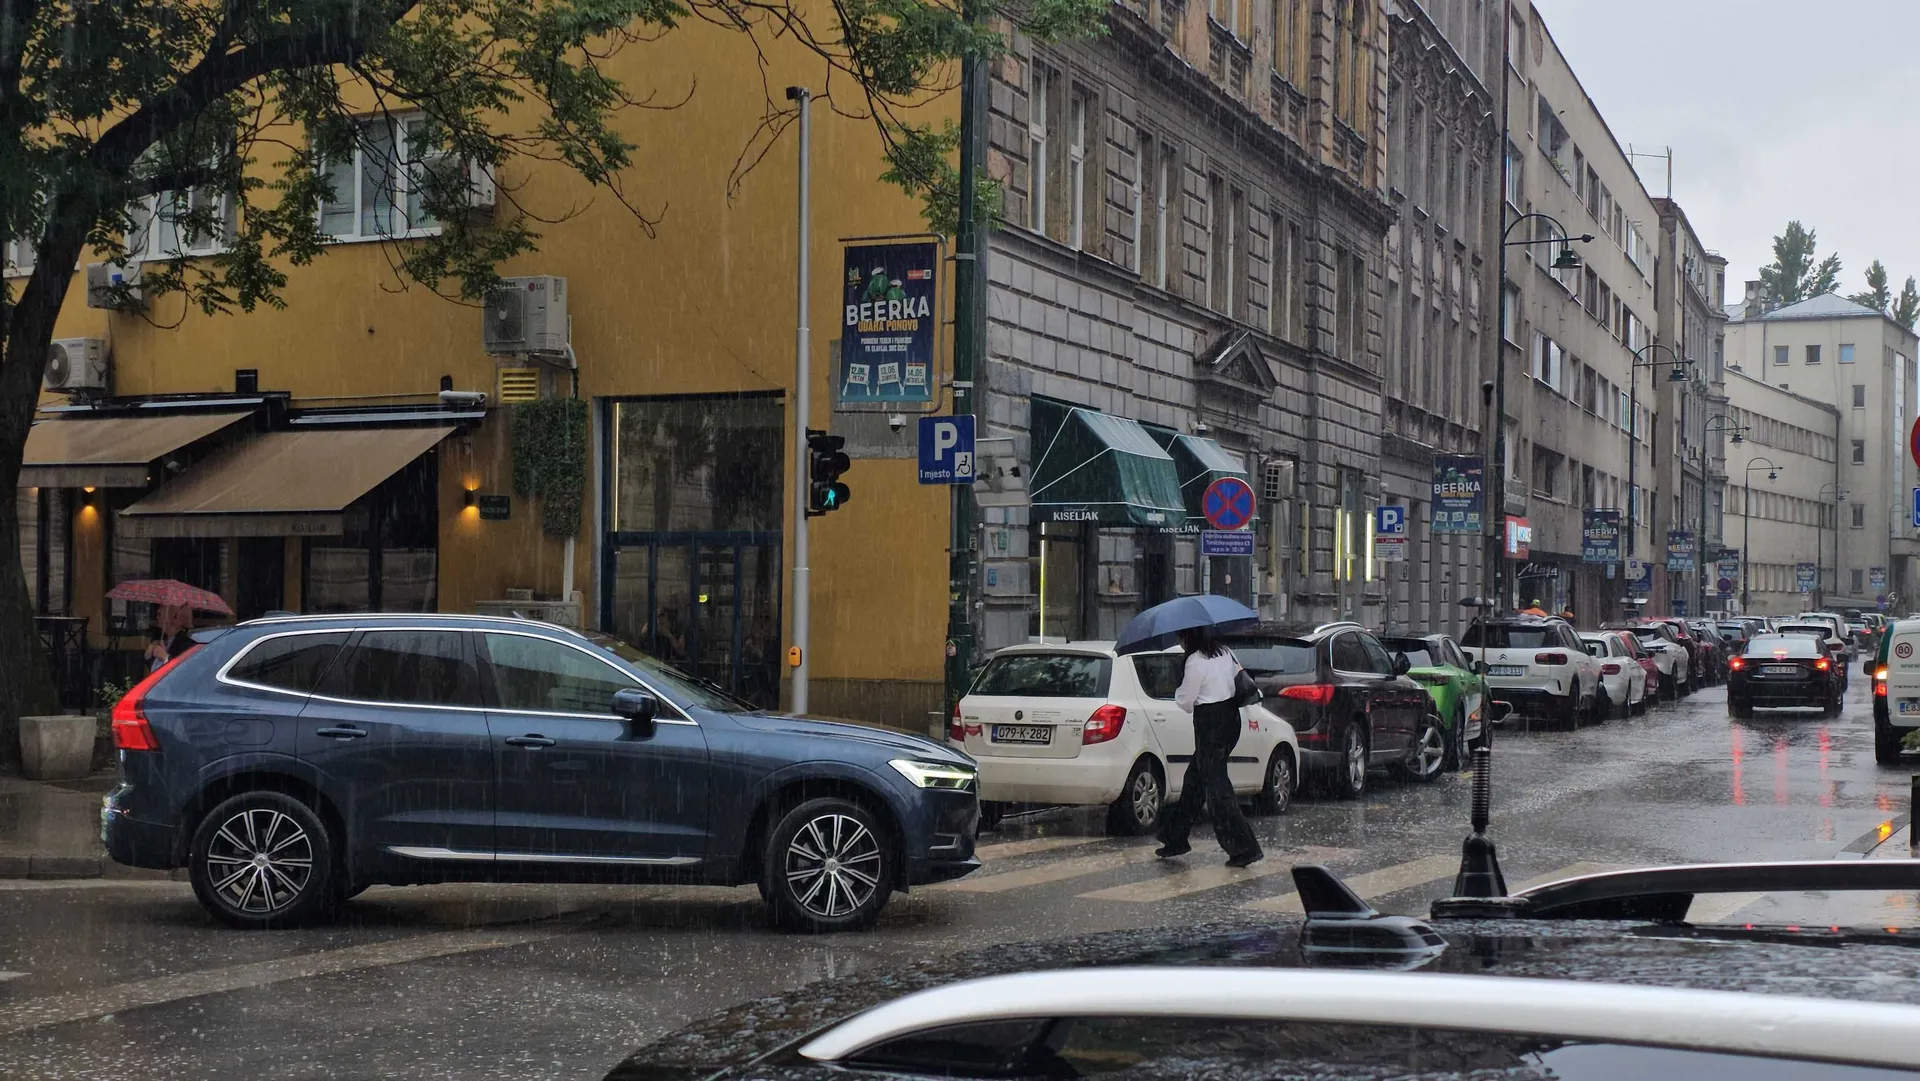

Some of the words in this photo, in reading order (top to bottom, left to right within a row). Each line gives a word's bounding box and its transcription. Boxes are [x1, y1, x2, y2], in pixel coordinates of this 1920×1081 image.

[846, 296, 930, 326] BEERKA
[858, 320, 884, 332] UDARA
[886, 319, 918, 331] PONOVO
[935, 423, 957, 460] P
[924, 470, 950, 480] mjesto
[1434, 481, 1481, 494] BEERKA
[1053, 511, 1098, 521] KISELJAK
[1383, 510, 1397, 530] P
[1584, 528, 1618, 537] BEERKA
[1898, 646, 1909, 654] 80
[999, 727, 1049, 740] 079-K-282
